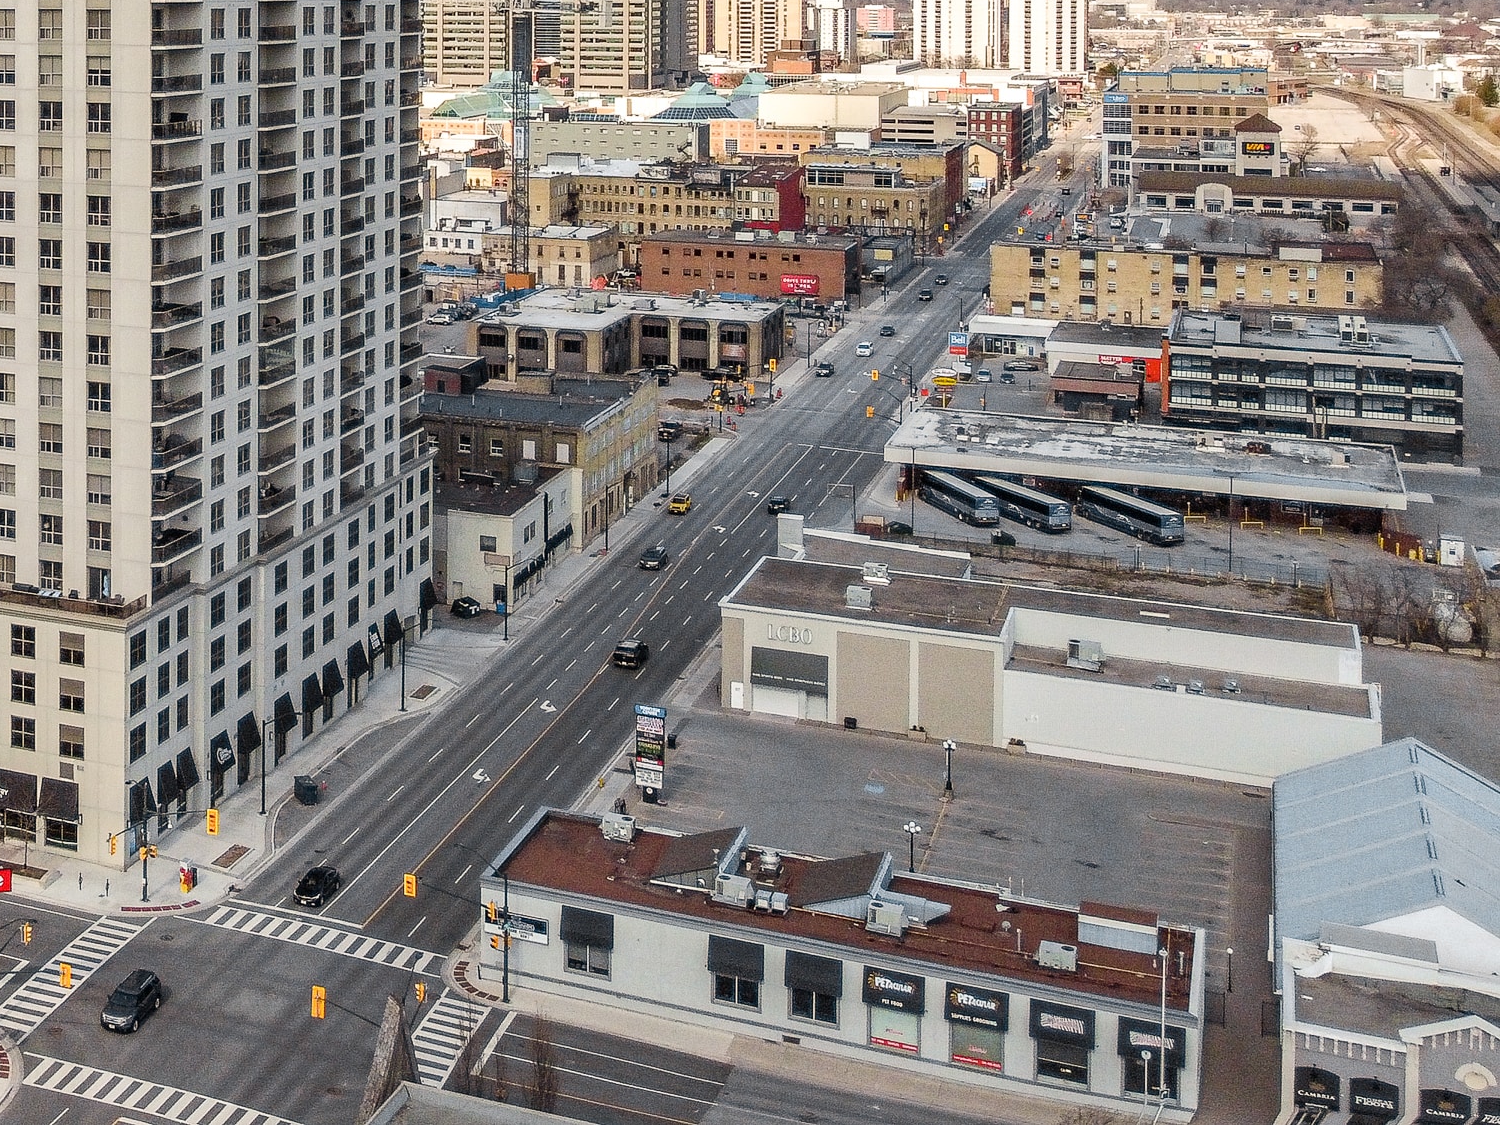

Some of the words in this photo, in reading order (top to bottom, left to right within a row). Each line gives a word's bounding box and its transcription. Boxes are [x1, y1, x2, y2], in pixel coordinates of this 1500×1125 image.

[1246, 142, 1266, 151] VIA
[951, 335, 966, 344] Bell
[768, 624, 813, 645] LCBO
[1297, 1089, 1336, 1101] CAMBRIA
[1425, 1108, 1465, 1119] CAMBRIA
